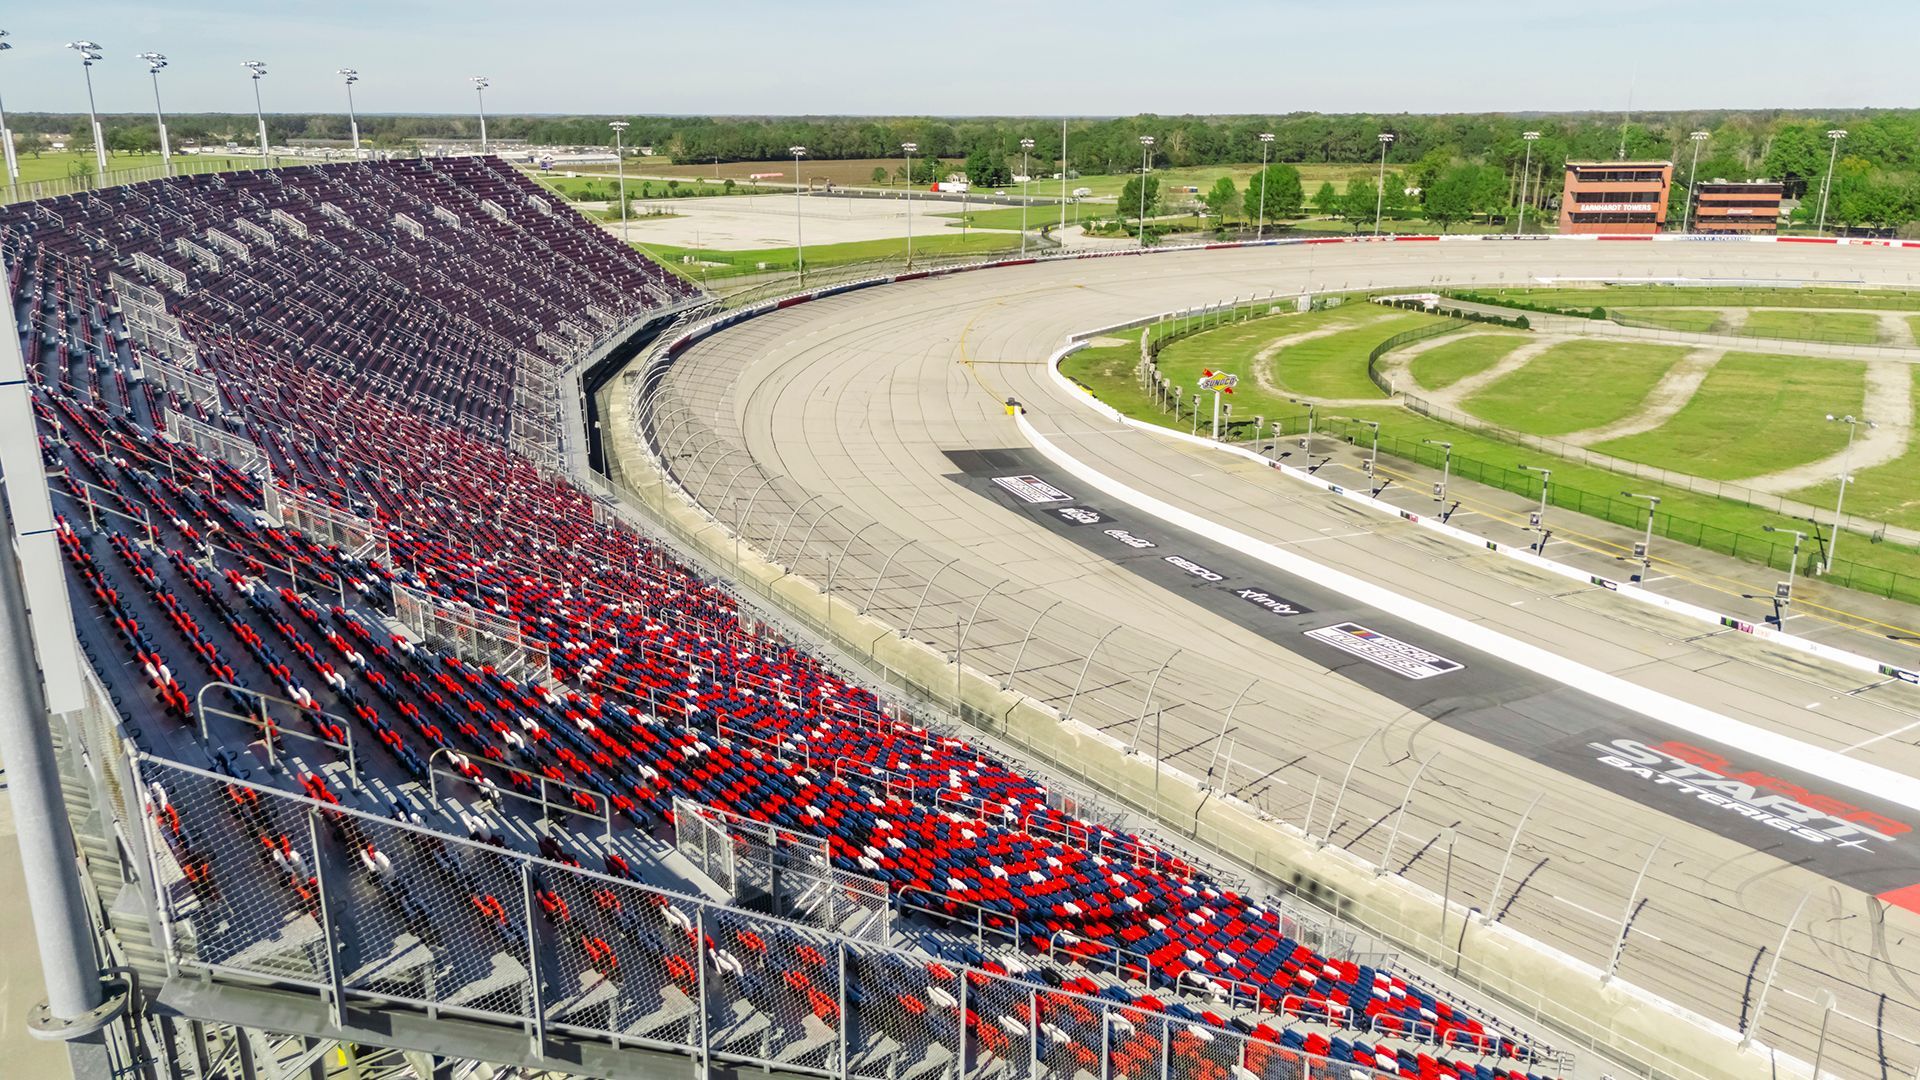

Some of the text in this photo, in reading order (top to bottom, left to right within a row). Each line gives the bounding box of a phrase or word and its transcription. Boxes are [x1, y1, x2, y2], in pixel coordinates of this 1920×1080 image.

[1203, 376, 1236, 389] SUNOCO
[1165, 555, 1224, 581] GEICO
[1237, 588, 1300, 616] xfinity
[1359, 645, 1423, 669] SERIES
[1367, 636, 1441, 663] NASCAR
[1596, 755, 1834, 843] BATTERIES
[1609, 738, 1897, 842] START
[1648, 739, 1914, 836] SUPER
